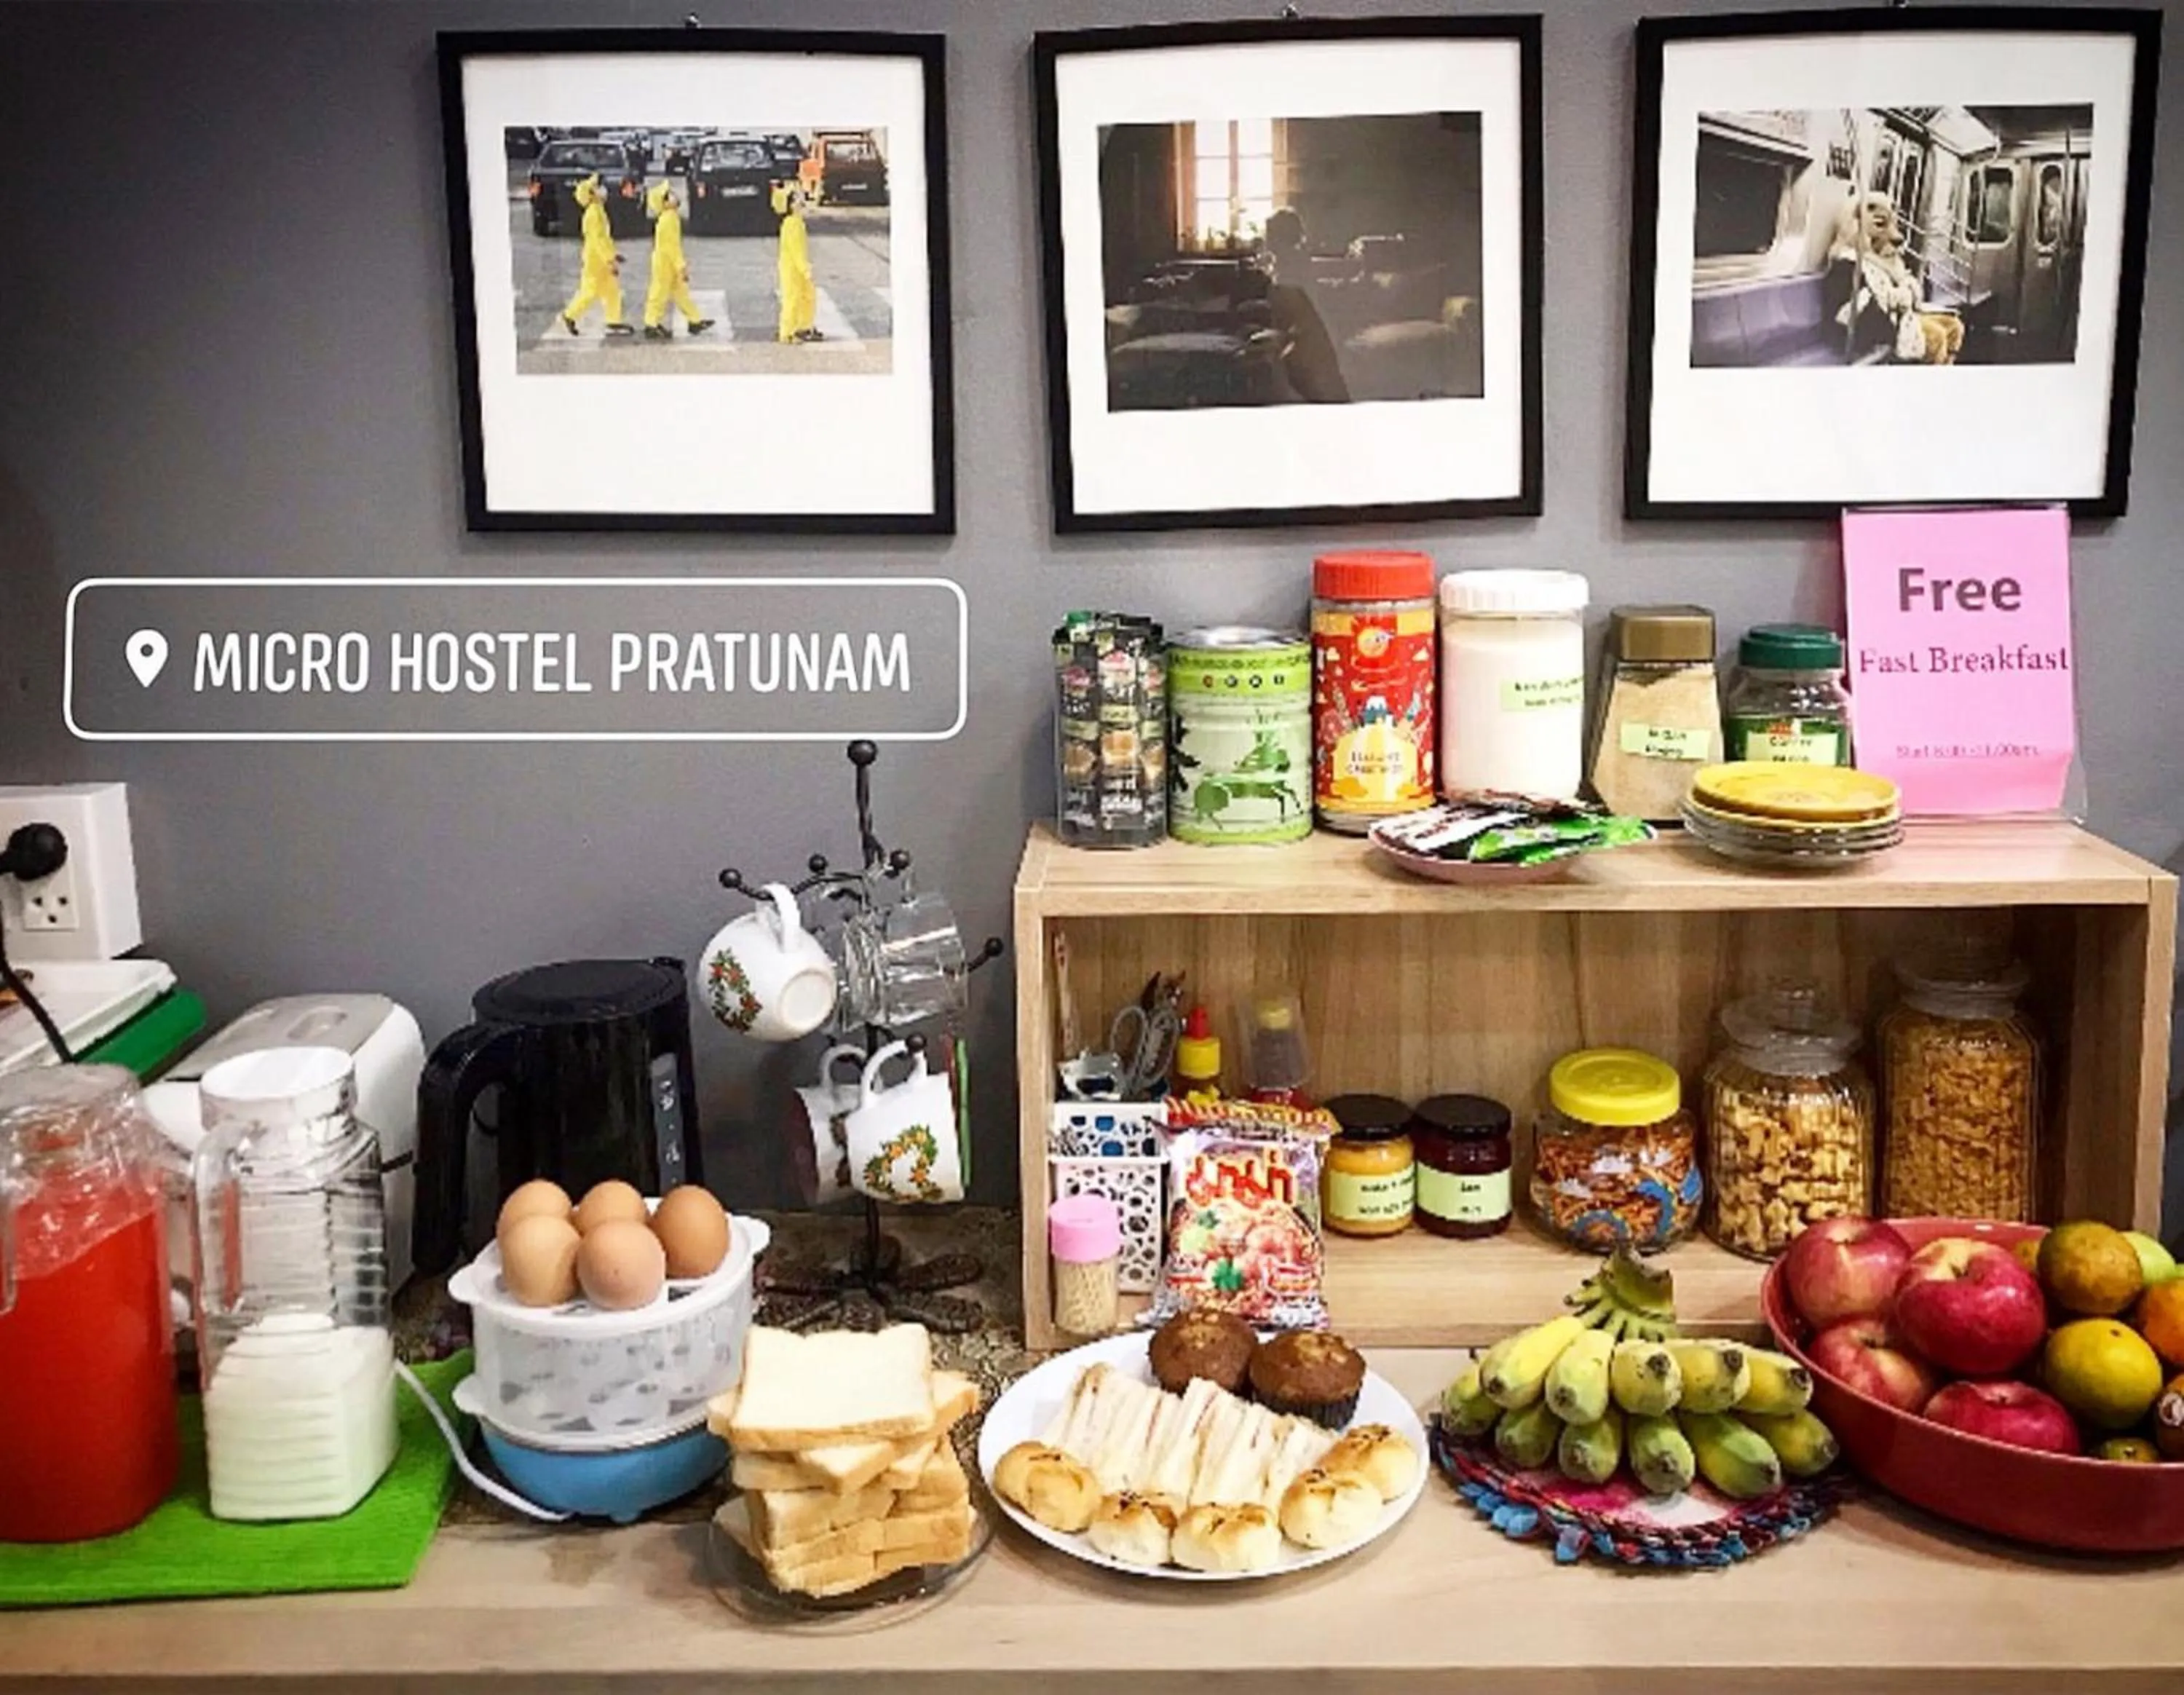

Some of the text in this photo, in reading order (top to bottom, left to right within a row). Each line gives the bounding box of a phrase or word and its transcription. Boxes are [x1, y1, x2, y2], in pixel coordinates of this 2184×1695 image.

[1898, 566, 2022, 612] Free
[1859, 642, 2068, 673] Fast Breakfast
